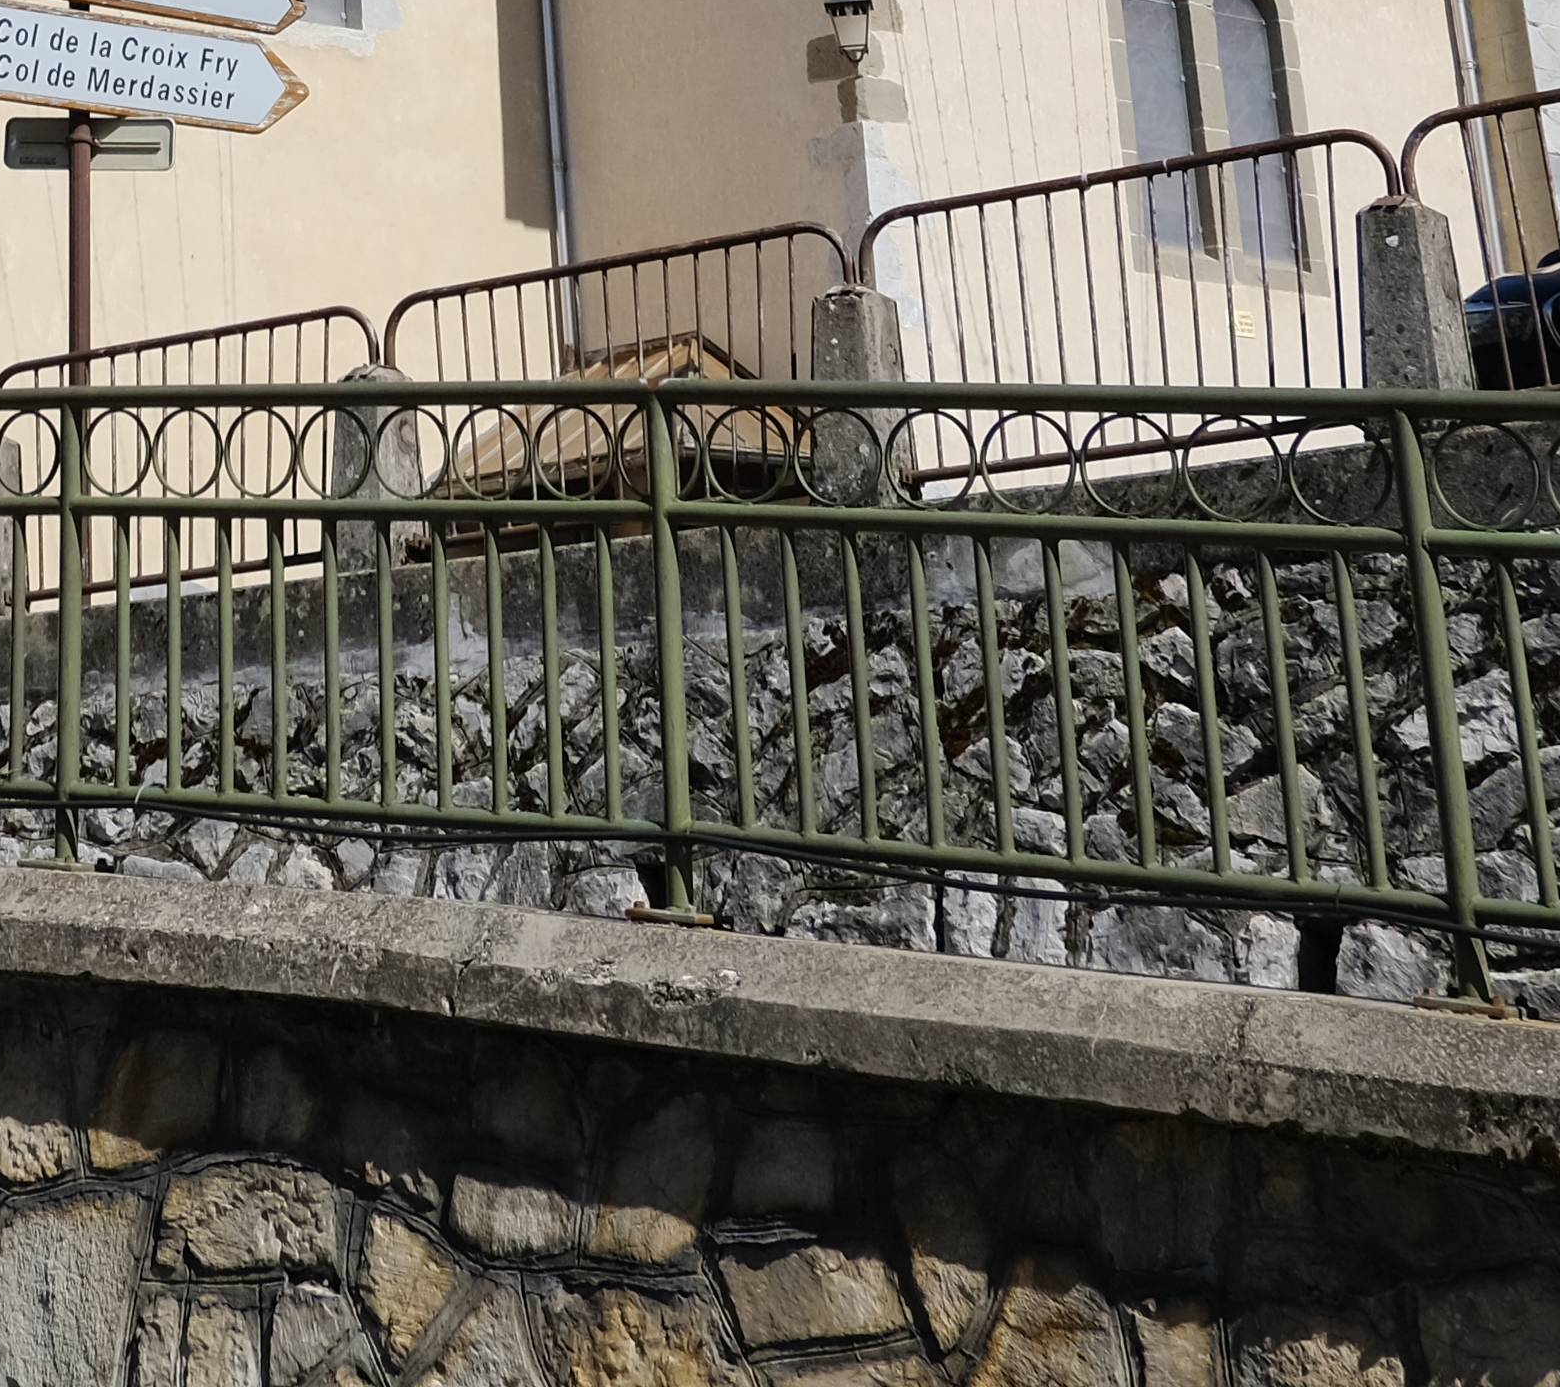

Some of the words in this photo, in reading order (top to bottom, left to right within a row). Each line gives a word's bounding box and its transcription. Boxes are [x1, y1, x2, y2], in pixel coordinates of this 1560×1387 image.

[49, 27, 79, 53] de
[90, 31, 112, 58] la
[121, 37, 189, 69] Croix
[199, 48, 239, 81] Fry
[47, 62, 76, 88] de
[87, 66, 236, 110] Merdassier
